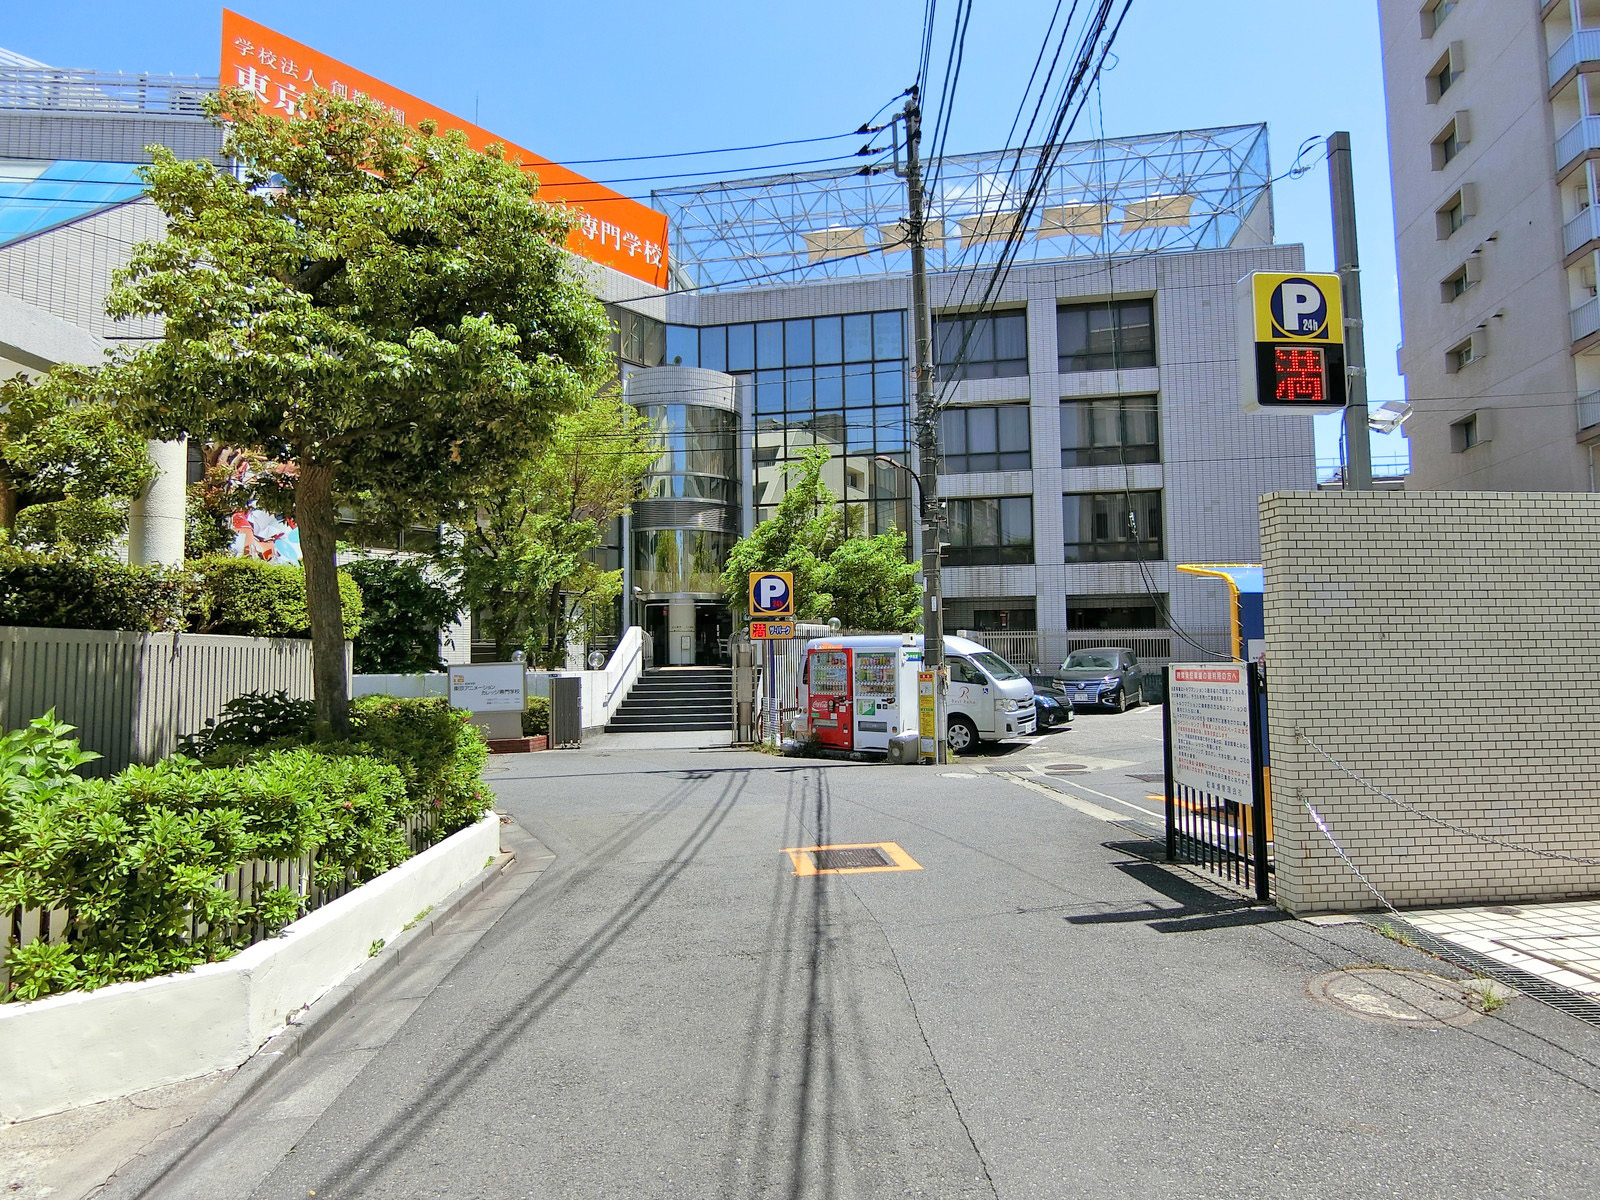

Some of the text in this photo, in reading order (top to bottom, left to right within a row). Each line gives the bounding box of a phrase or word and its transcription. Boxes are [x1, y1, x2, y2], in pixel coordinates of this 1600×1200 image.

[234, 37, 319, 88] 学校法人
[1281, 283, 1321, 331] P
[1302, 319, 1319, 331] 24h
[1275, 350, 1323, 399] 満
[761, 578, 786, 608] P
[752, 623, 767, 638] 満
